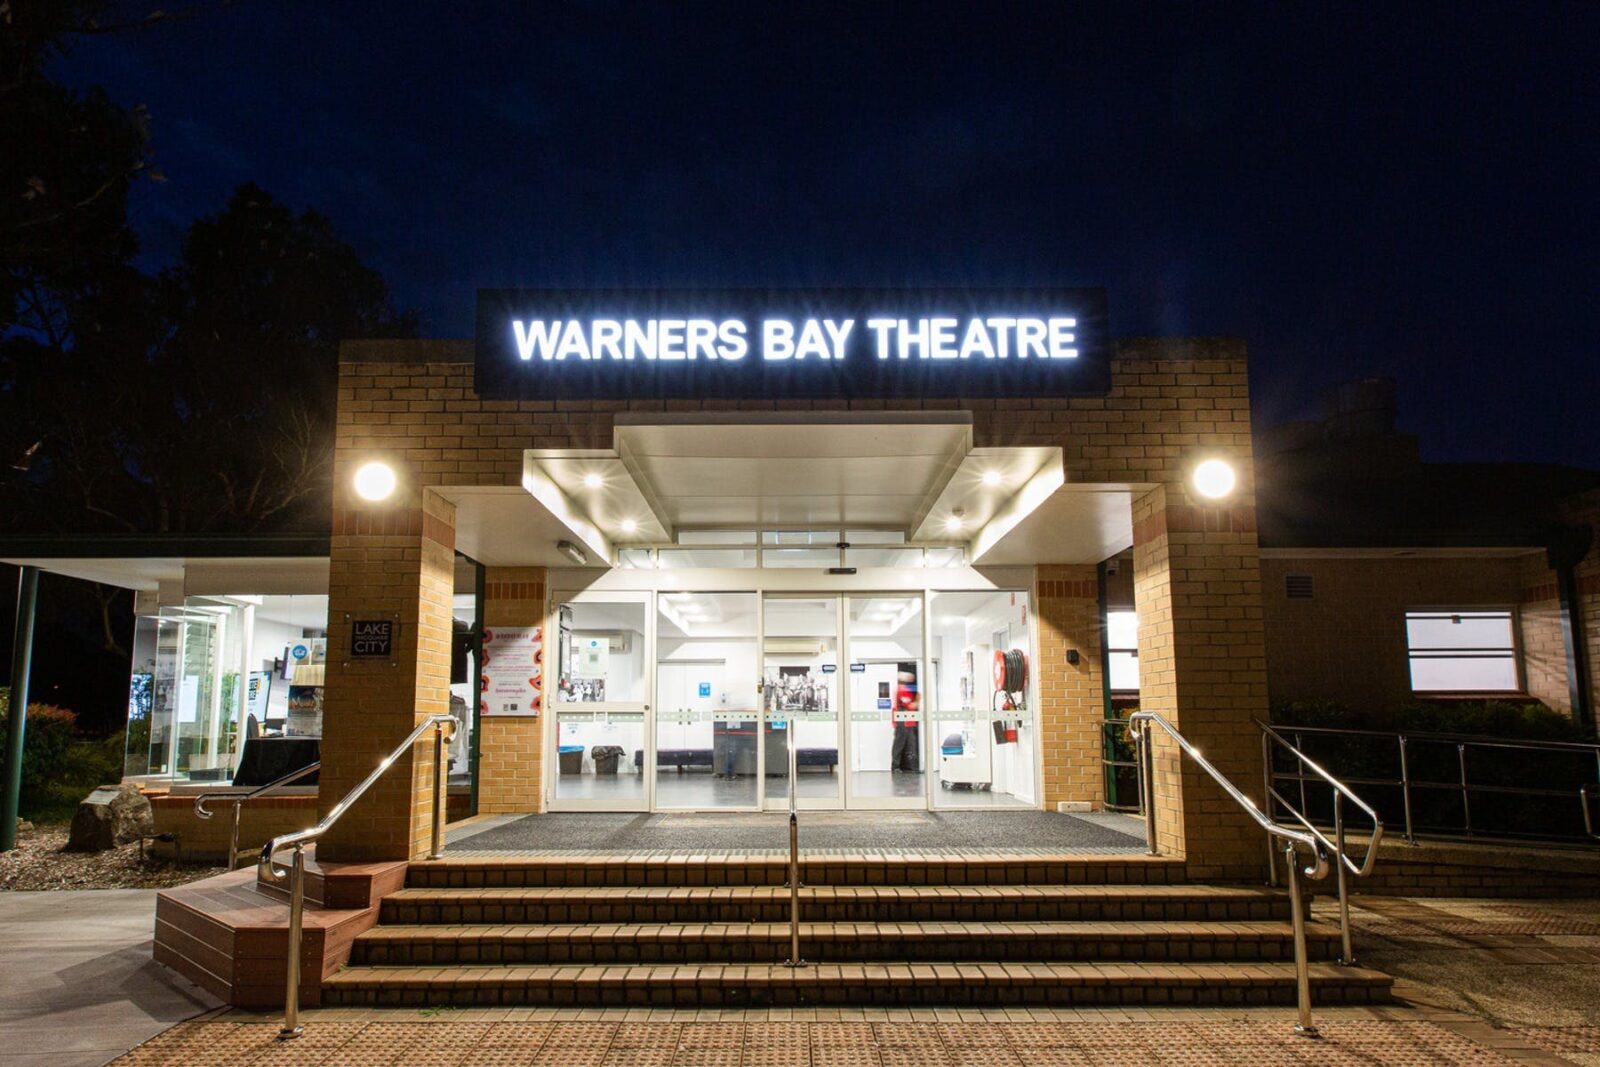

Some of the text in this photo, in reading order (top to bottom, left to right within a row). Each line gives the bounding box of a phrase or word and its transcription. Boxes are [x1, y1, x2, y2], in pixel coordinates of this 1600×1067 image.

[511, 317, 1079, 361] WARNERS BAY THEATRE
[355, 623, 390, 635] LAKE
[354, 641, 388, 653] CITY
